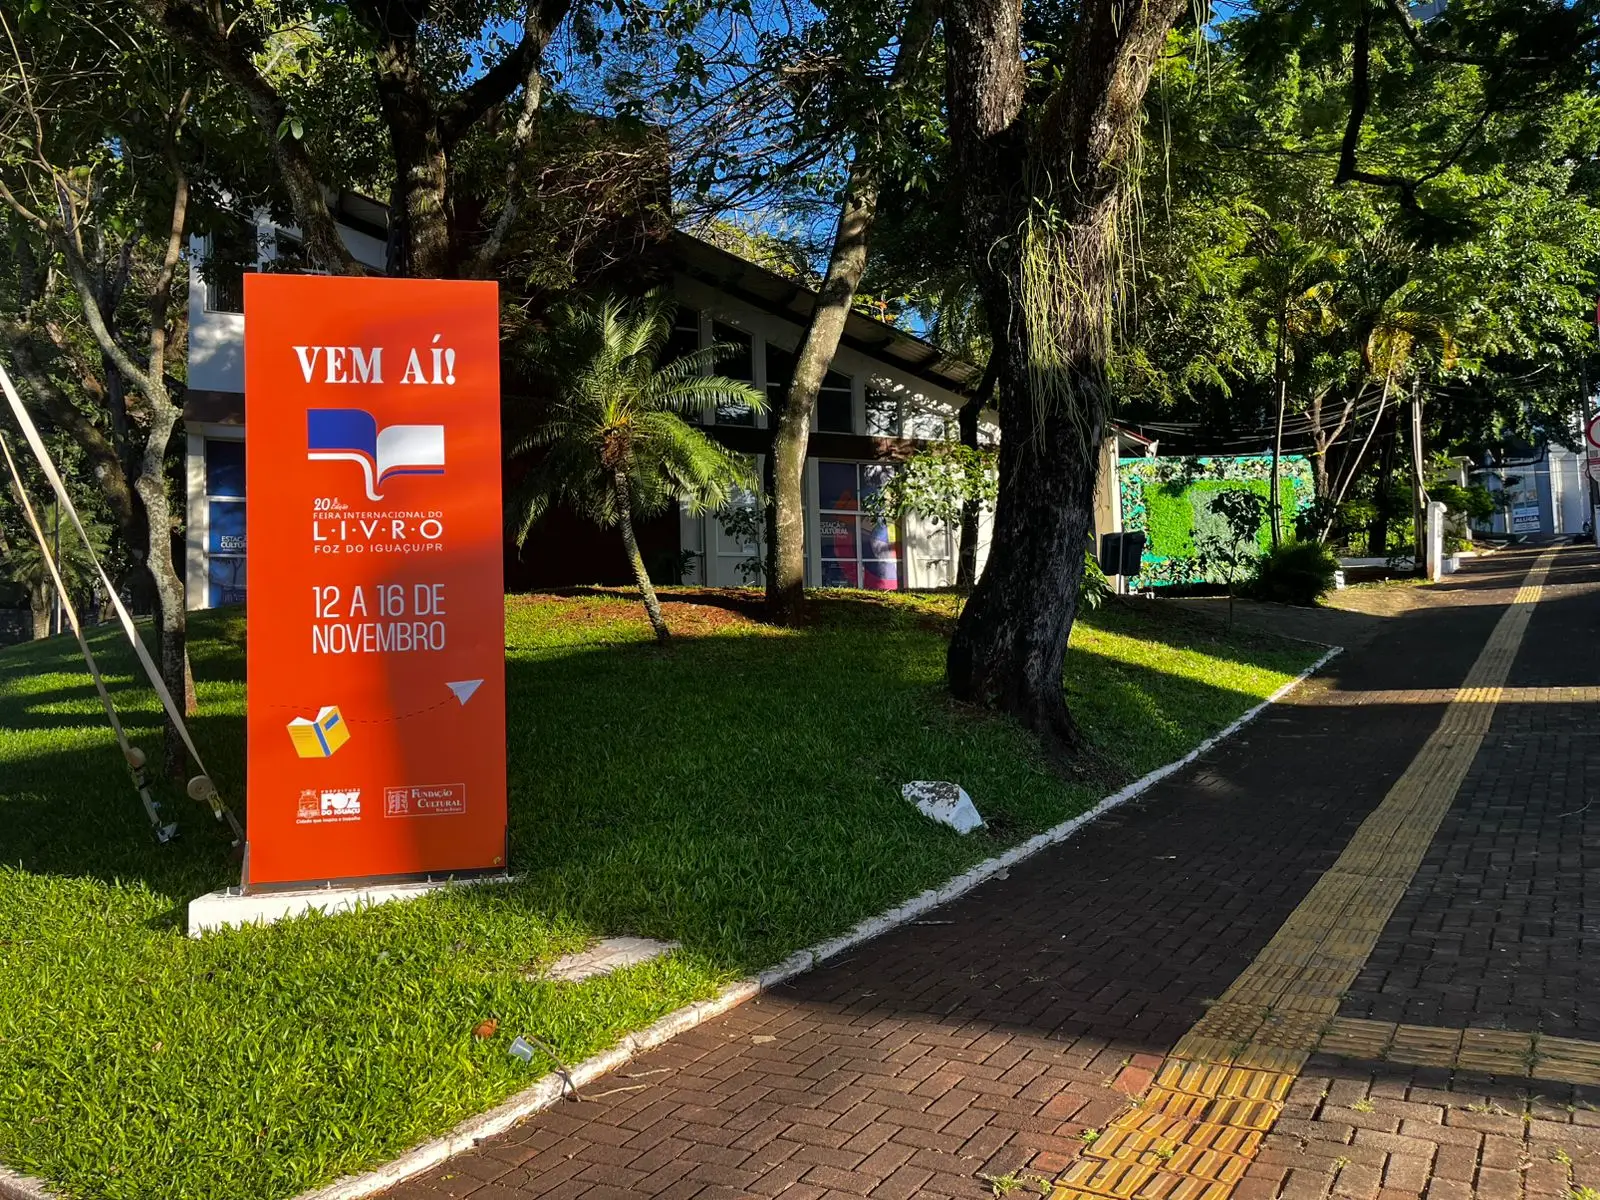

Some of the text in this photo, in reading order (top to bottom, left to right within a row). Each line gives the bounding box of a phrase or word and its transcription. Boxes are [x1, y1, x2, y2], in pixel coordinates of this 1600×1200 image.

[292, 334, 456, 385] VEM AÍ!
[313, 510, 443, 520] FEIRA INTERNACIONAL DO
[1515, 515, 1539, 523] ALUGA
[314, 542, 443, 554] FOZ DO IGUAÇU/PR
[312, 583, 446, 618] 12 A 16 DE
[312, 621, 446, 654] NOVEMBRO
[321, 792, 361, 810] FOZ
[333, 807, 361, 816] IGUAÇU
